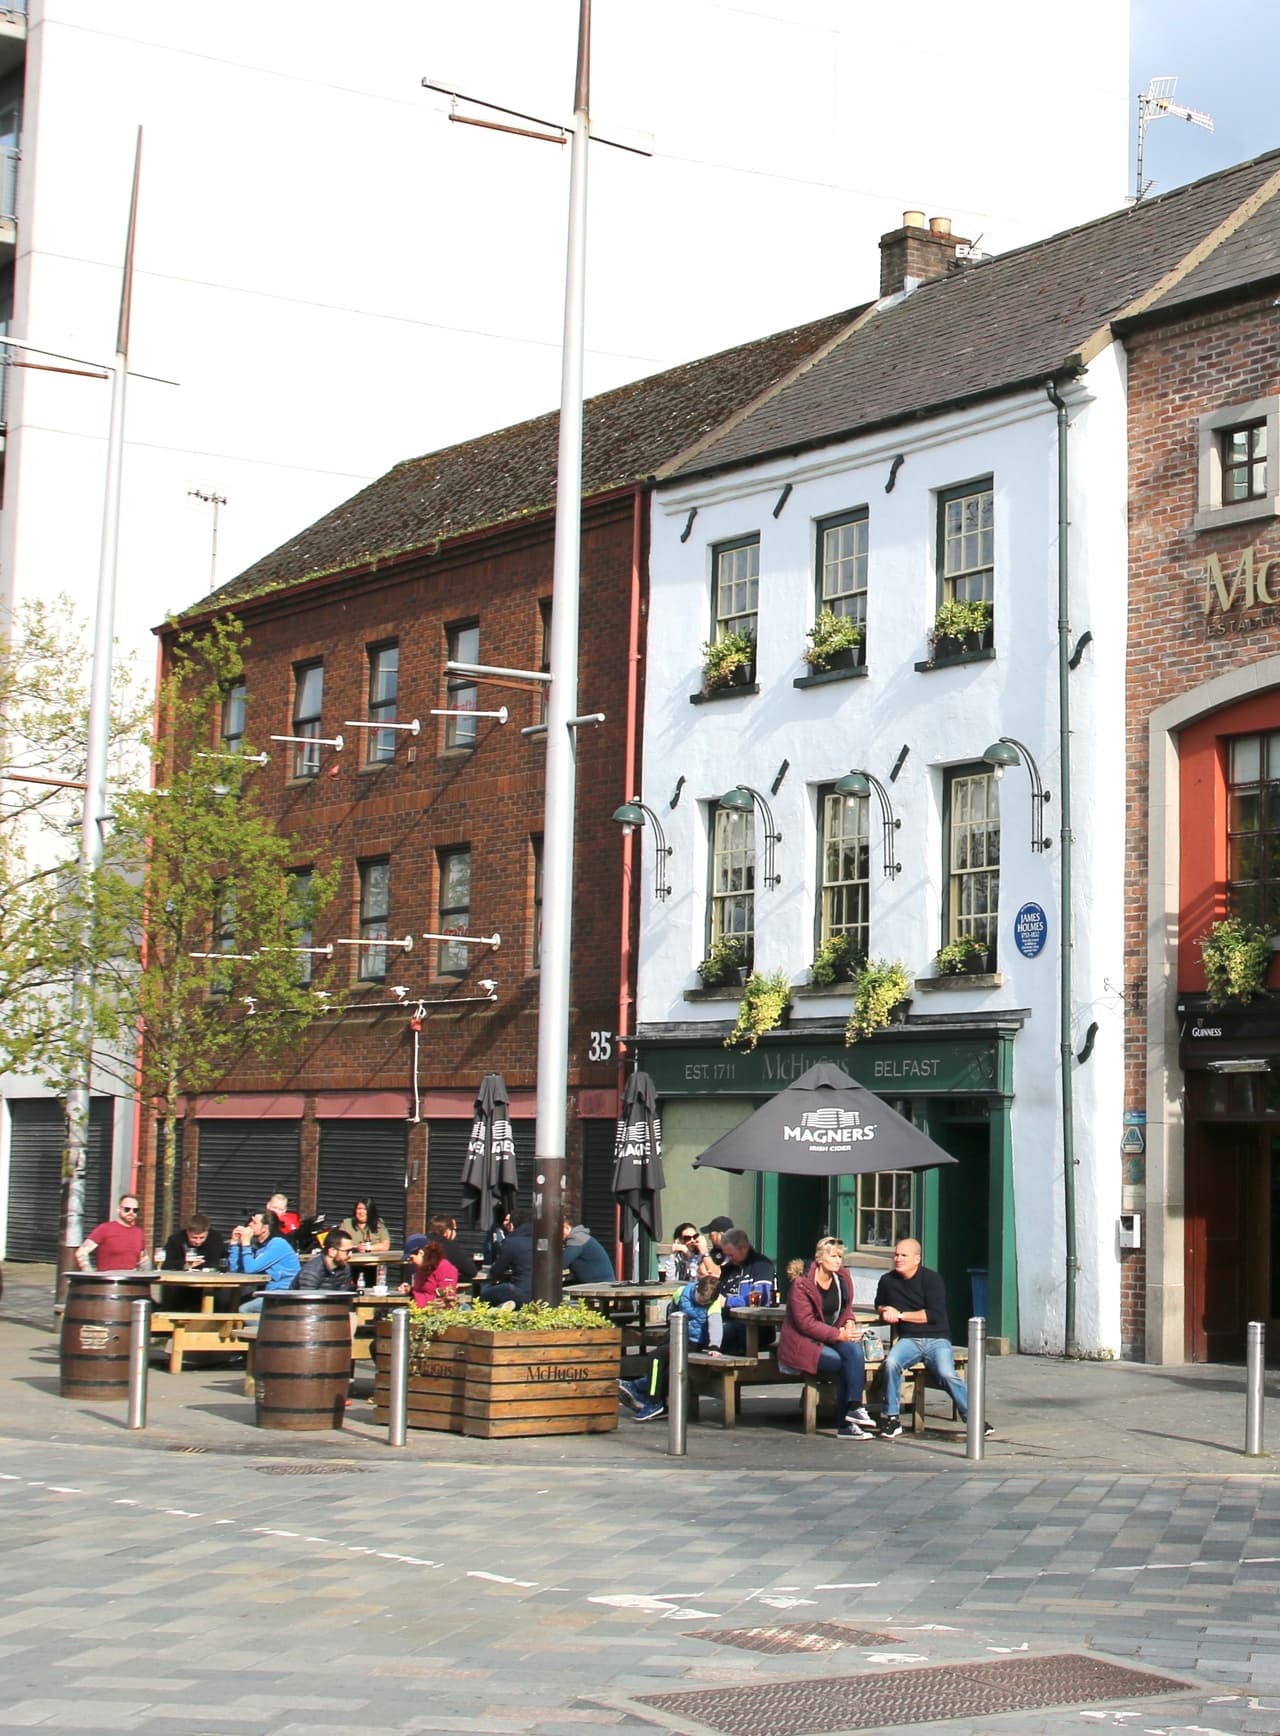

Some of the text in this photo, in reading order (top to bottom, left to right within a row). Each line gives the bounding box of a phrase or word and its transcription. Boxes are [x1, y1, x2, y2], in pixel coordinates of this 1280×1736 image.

[1021, 912, 1040, 921] JAMES
[1018, 921, 1043, 932] HOLMES
[1192, 1027, 1222, 1037] GUINNESS
[589, 1031, 612, 1062] 35
[685, 1063, 736, 1080] EST. 1711
[874, 1059, 940, 1078] BELFAST
[783, 1125, 877, 1143] MAGNERS
[829, 1144, 851, 1152] CIDER
